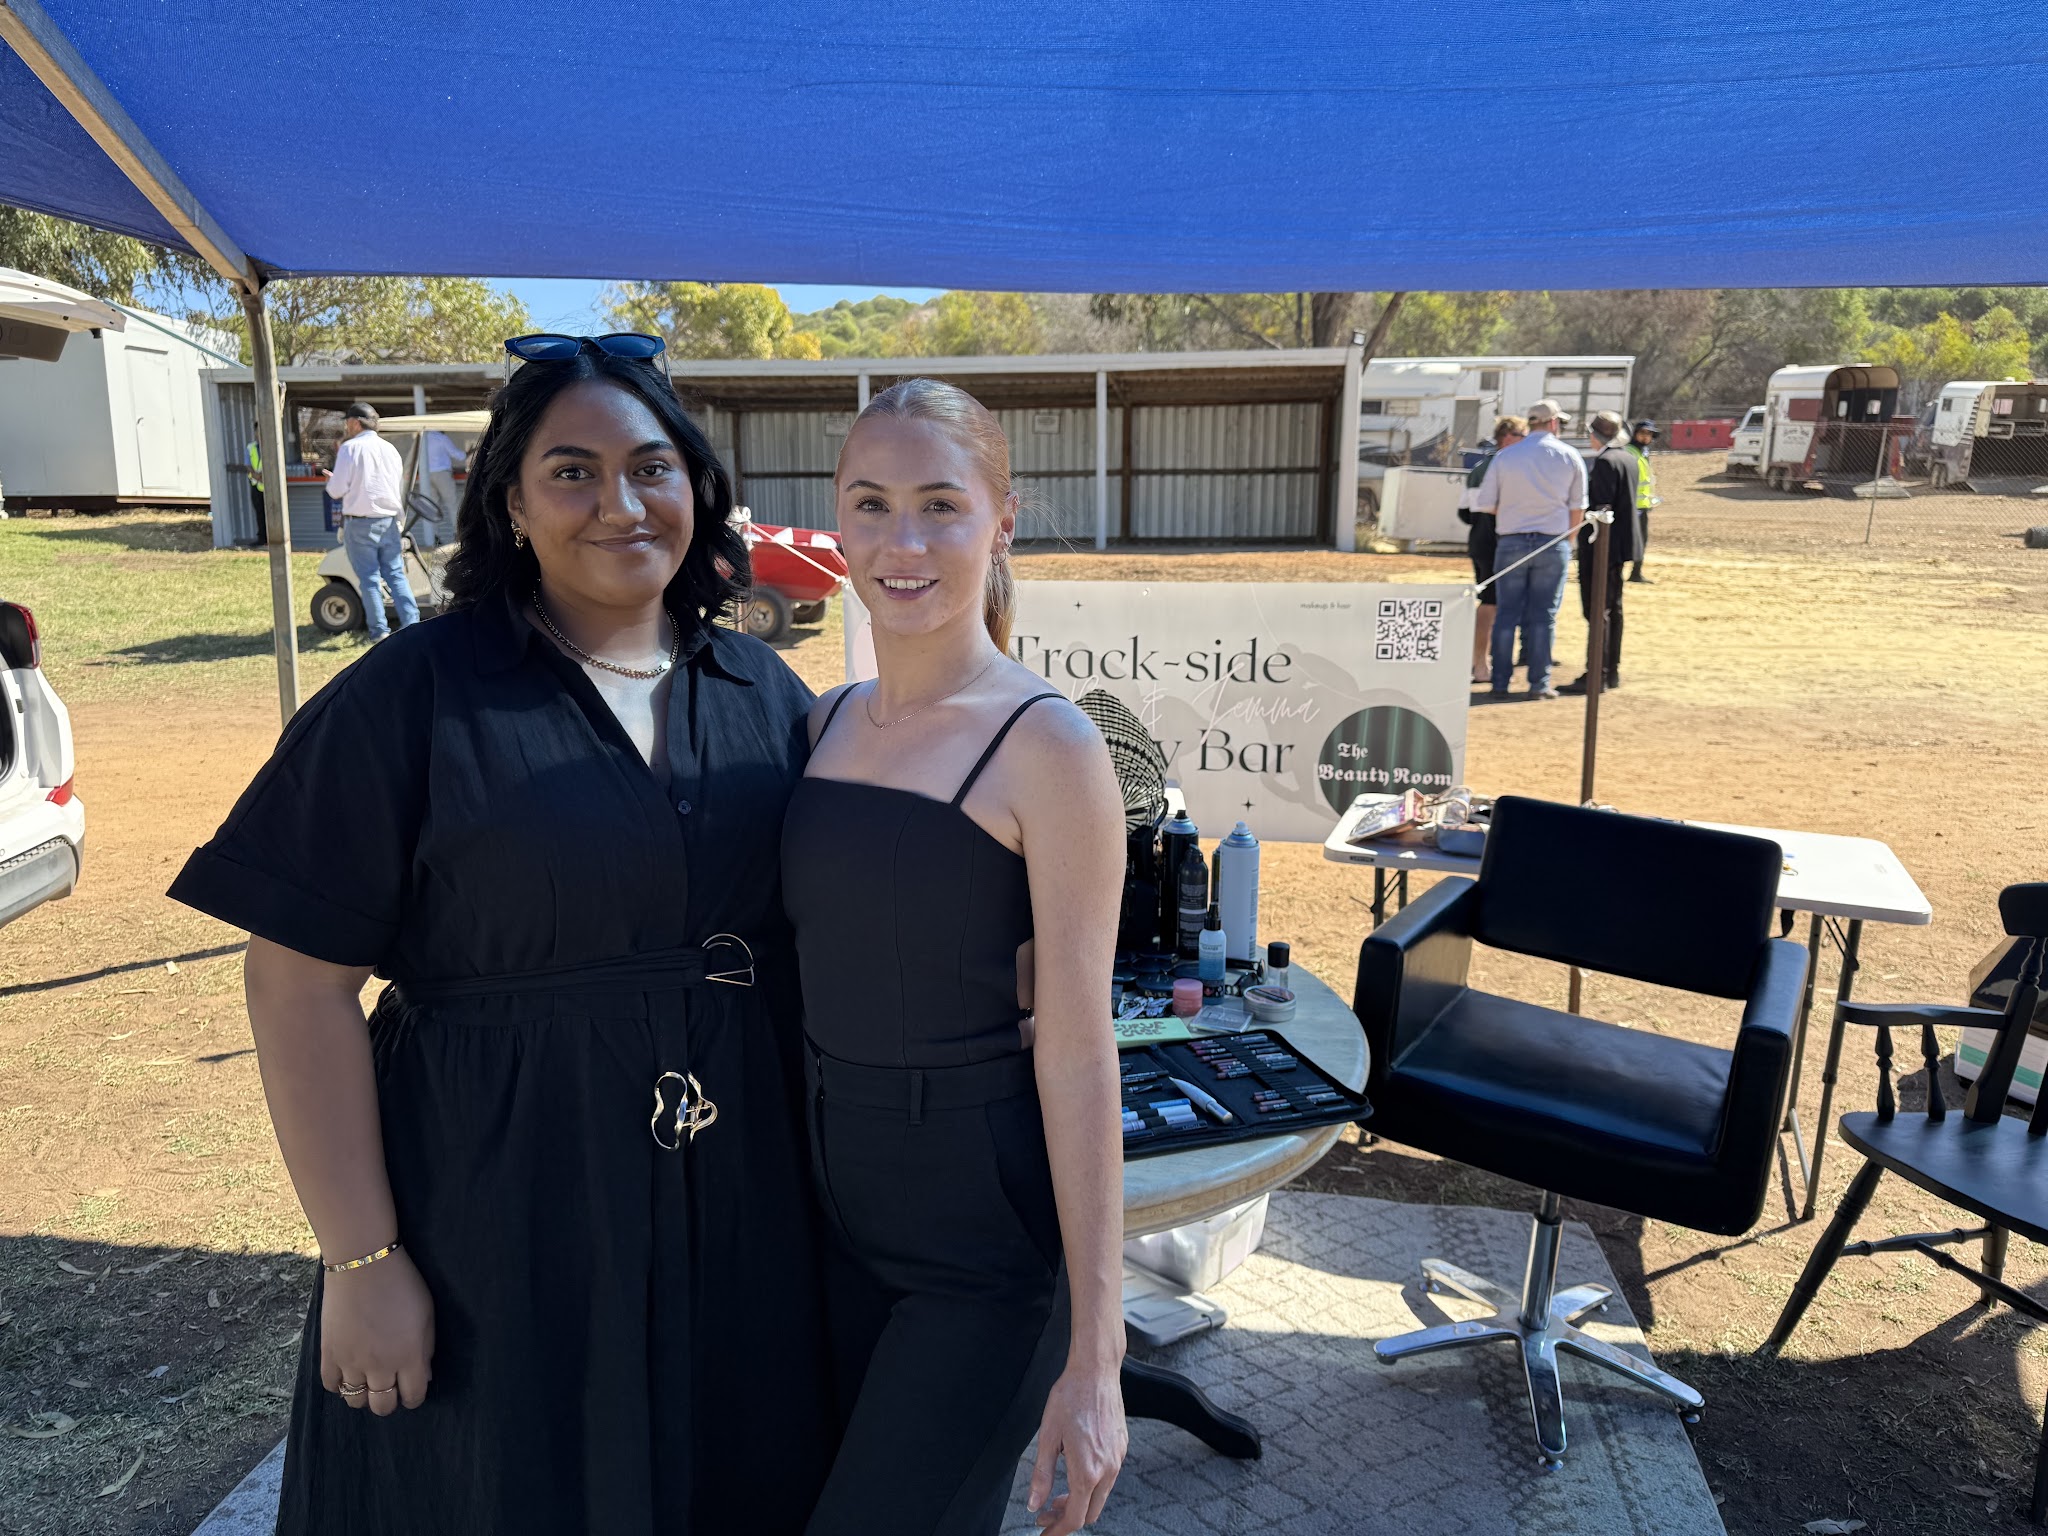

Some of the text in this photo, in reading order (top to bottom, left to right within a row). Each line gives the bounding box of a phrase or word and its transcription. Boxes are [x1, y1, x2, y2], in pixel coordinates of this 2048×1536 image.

[1010, 634, 1292, 684] Track-side
[1197, 728, 1296, 774] Bar
[1337, 742, 1369, 760] The
[1319, 763, 1452, 787] Beauty Room
